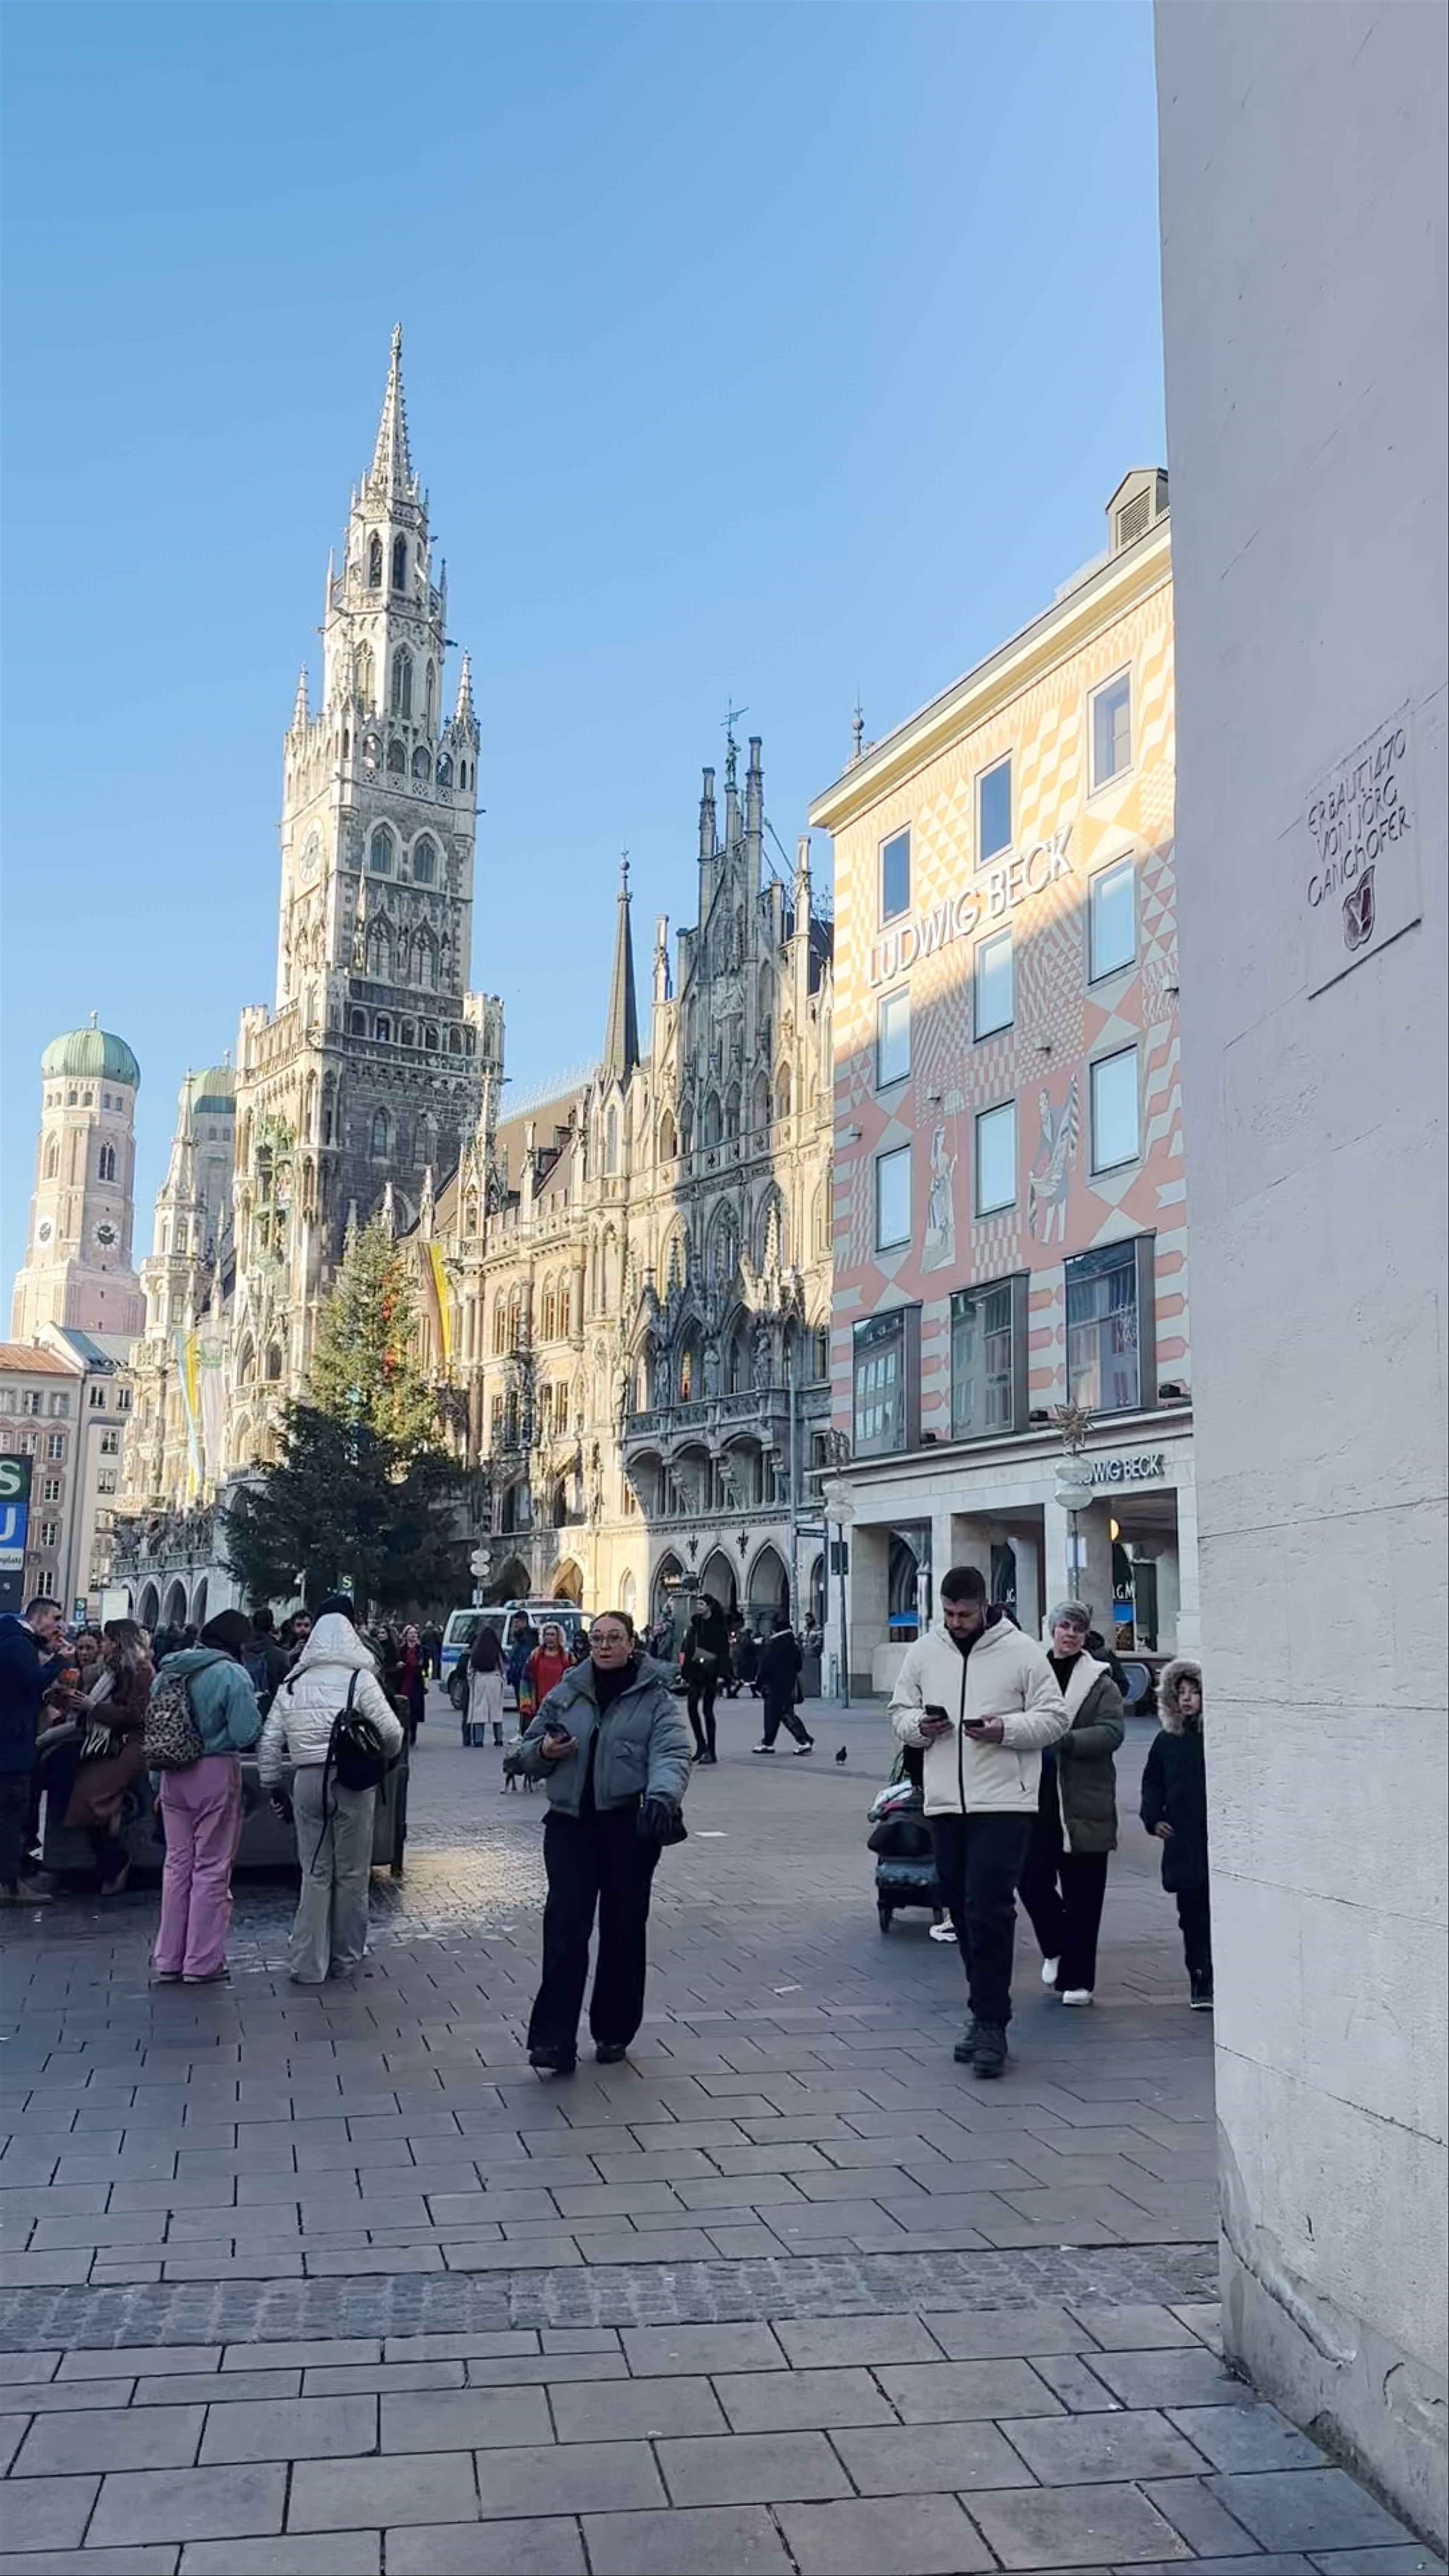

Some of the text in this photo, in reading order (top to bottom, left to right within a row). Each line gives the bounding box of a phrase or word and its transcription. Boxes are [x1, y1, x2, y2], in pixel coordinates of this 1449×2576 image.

[1308, 758, 1368, 835] ERBAUT
[1317, 813, 1351, 864] VON
[869, 823, 1074, 989] LUDWIG BECK
[0, 1461, 21, 1495] S
[1123, 1453, 1161, 1478] BECK
[343, 1575, 352, 1589] S
[76, 1613, 84, 1621] U
[77, 1599, 85, 1610] S
